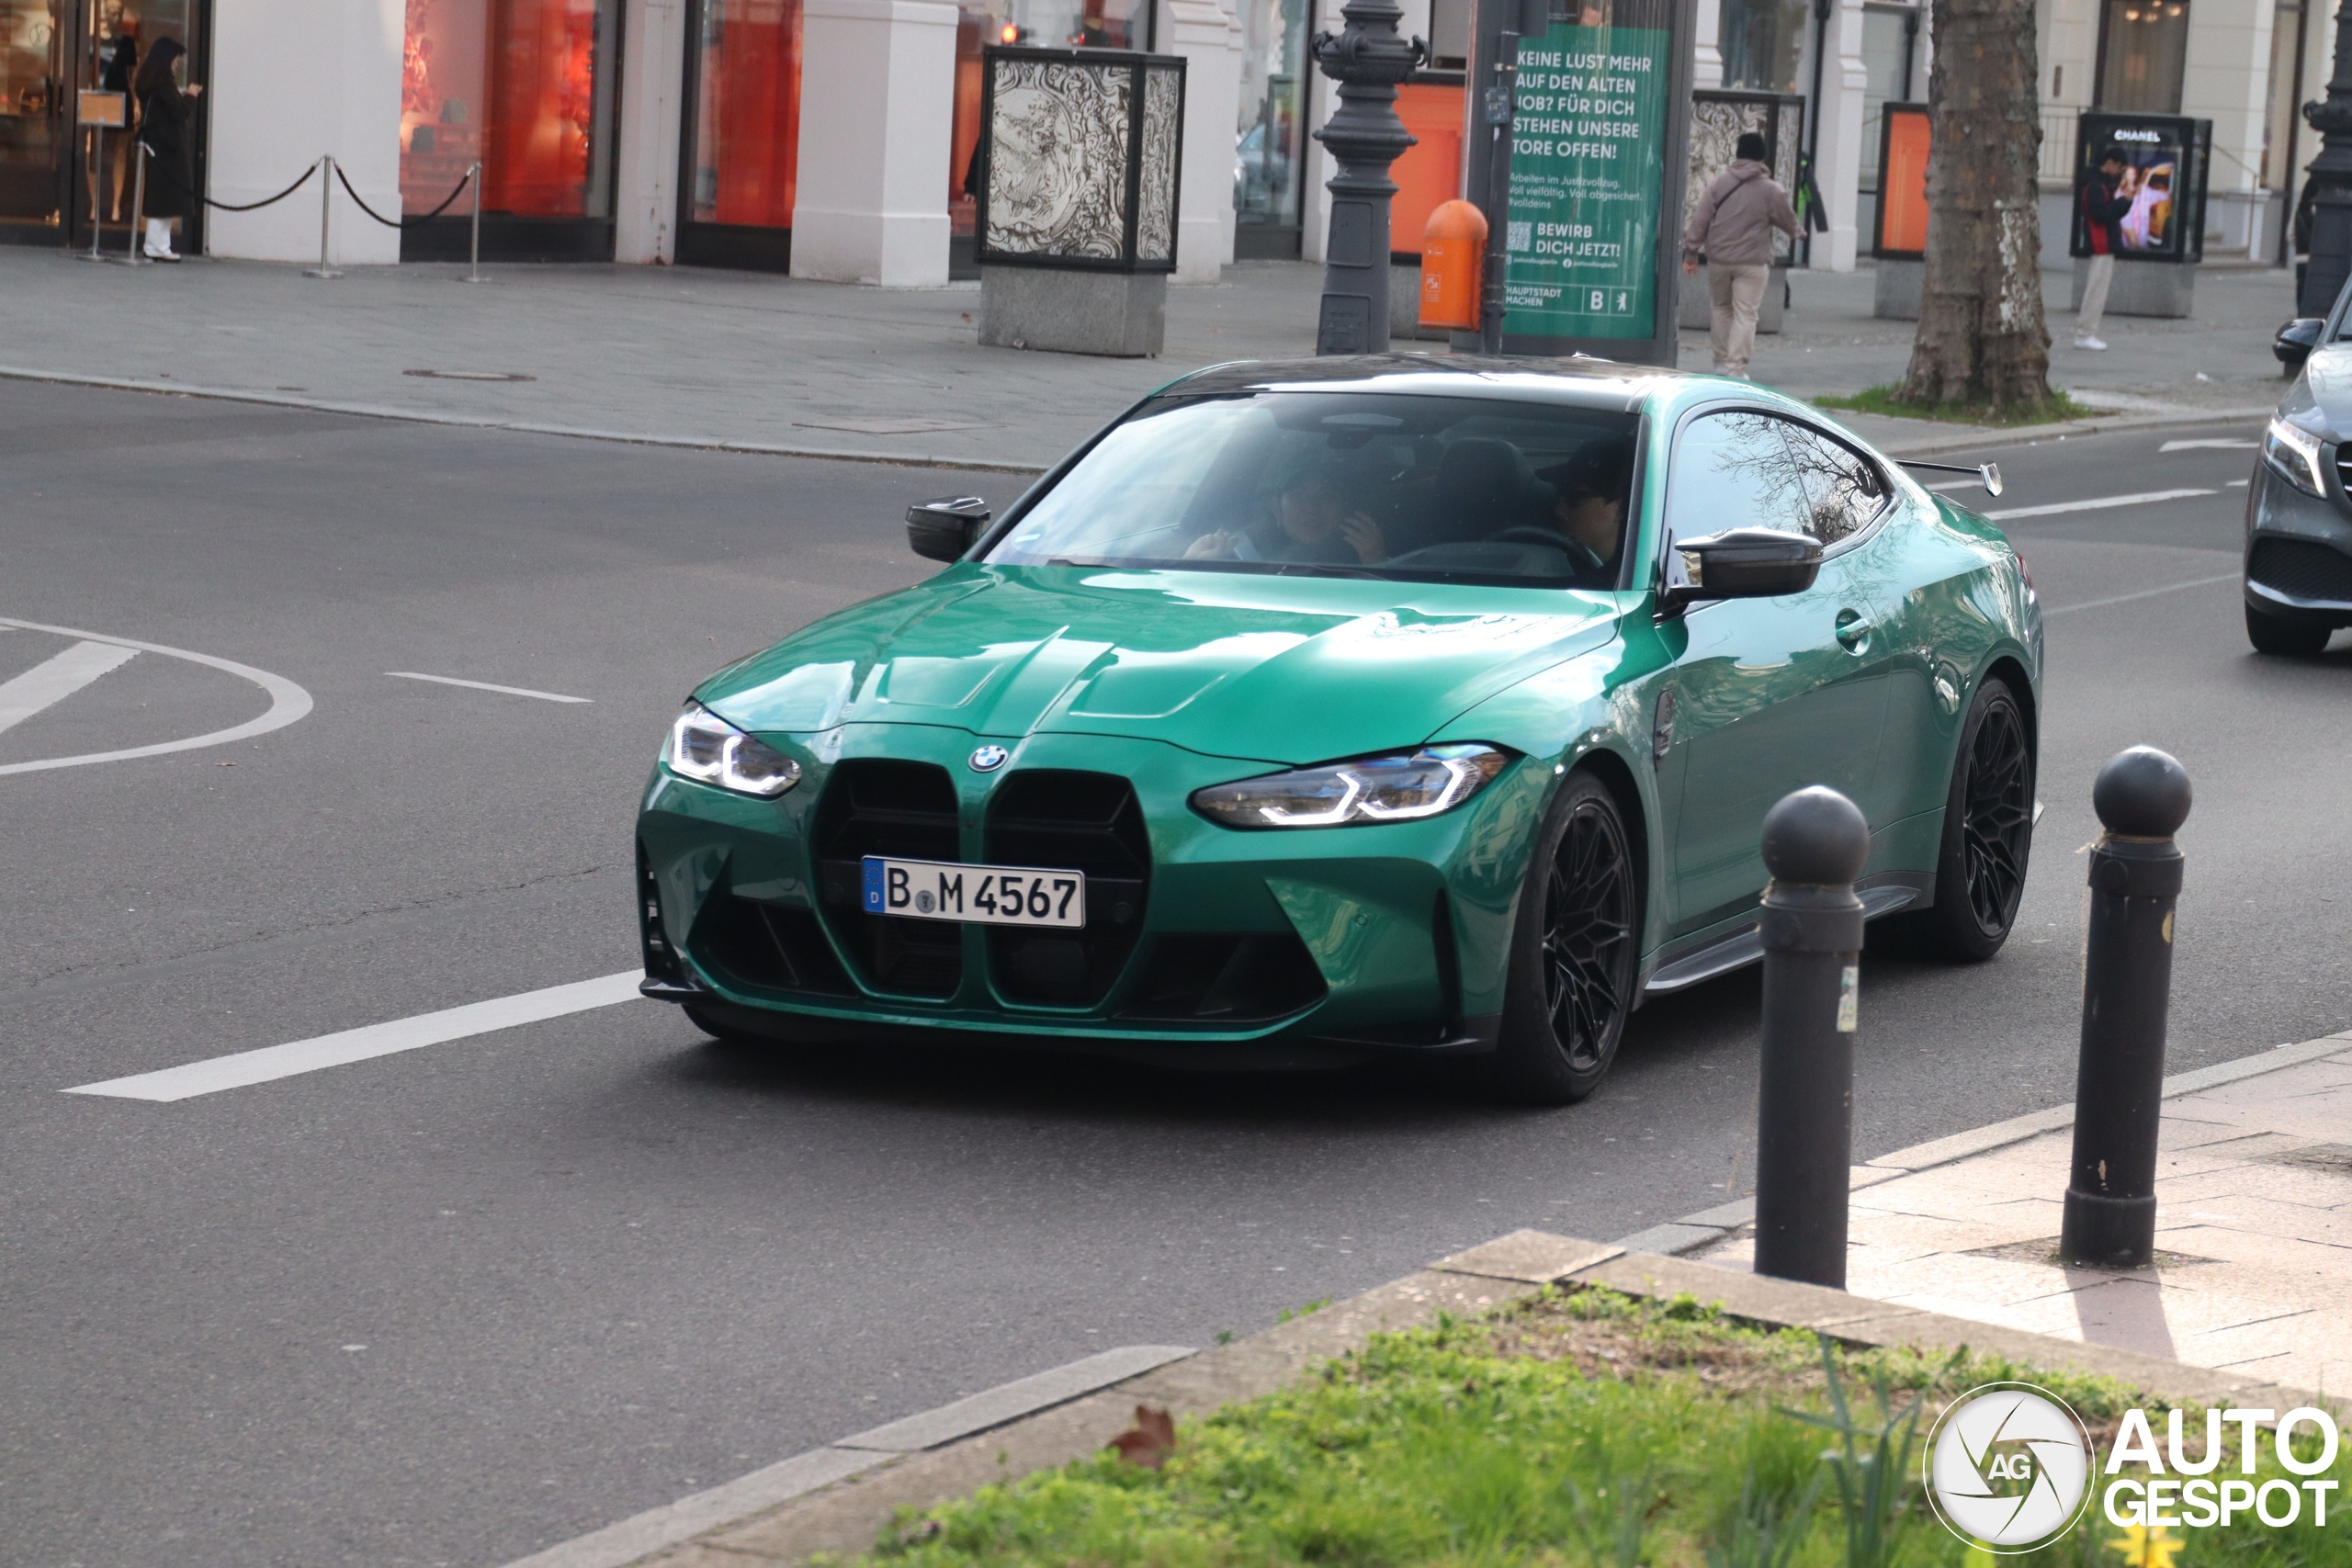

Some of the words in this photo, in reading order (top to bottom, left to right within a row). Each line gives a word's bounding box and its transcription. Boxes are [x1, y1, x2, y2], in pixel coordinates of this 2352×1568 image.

[1517, 51, 1562, 67] KEINE
[1566, 53, 1606, 70] LUST
[1609, 55, 1652, 73] MEHR
[1516, 73, 1545, 89] AUF
[1549, 74, 1583, 91] DEN
[1588, 76, 1635, 94] ALTEN
[1558, 94, 1589, 114] FÜR
[1595, 99, 1634, 116] DICH
[1513, 117, 1573, 135] STEHEN
[1577, 120, 1639, 138] UNSERE
[2114, 129, 2161, 142] CHANEL
[1512, 140, 1553, 155] TORE
[1556, 141, 1617, 159] OFFEN!
[1510, 173, 1544, 184] Arbeiten
[1547, 175, 1558, 185] im
[1561, 176, 1621, 190] Justizvollzug.
[1526, 186, 1566, 199] vielfältig.
[1569, 188, 1587, 198] Voll
[1589, 189, 1642, 202] abgesichert.
[1537, 222, 1593, 238] BEWIRB
[1536, 240, 1574, 255] DICH
[1576, 243, 1621, 257] JETZT!
[1506, 286, 1562, 299] HAUPTSTADT
[1590, 290, 1603, 310] B
[1505, 296, 1544, 307] MACHEN
[870, 892, 879, 904] D
[888, 867, 910, 908] B
[939, 872, 963, 913] M
[974, 875, 1077, 919] 4567
